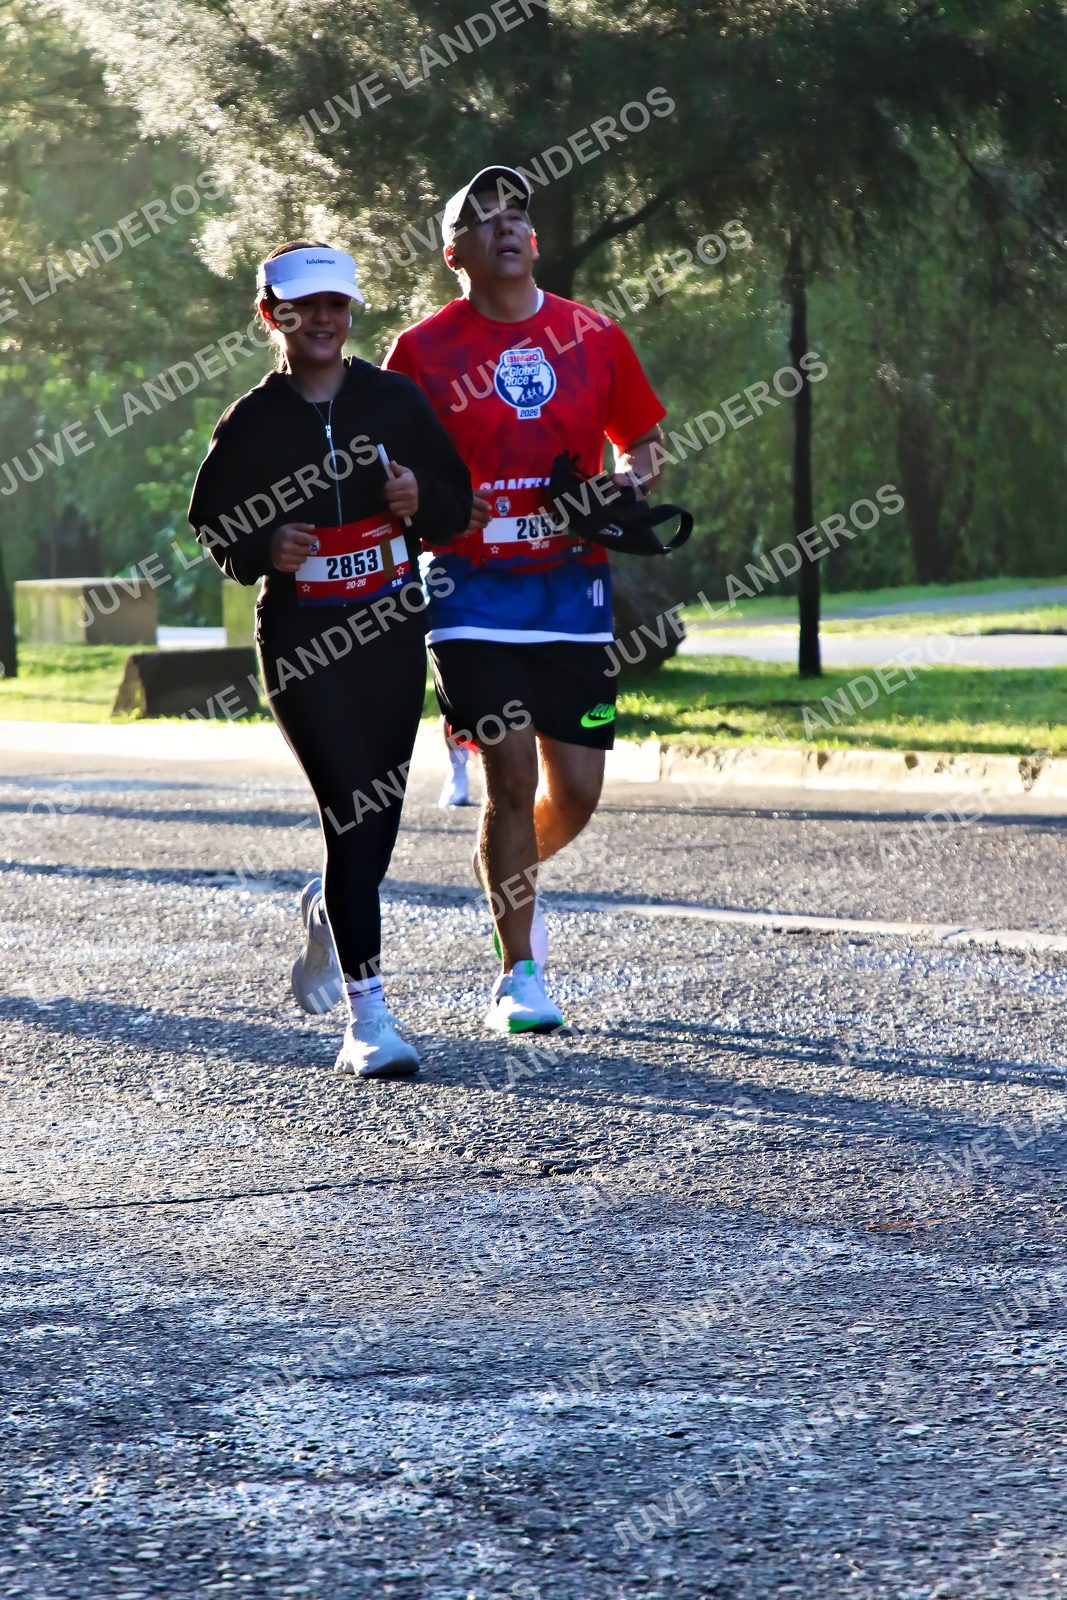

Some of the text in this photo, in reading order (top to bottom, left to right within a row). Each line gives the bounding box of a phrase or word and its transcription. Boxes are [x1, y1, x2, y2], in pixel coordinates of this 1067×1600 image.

[507, 353, 539, 363] BIMBO
[509, 365, 540, 376] Global
[504, 375, 529, 387] Race
[520, 408, 538, 417] 2026
[326, 548, 379, 579] 2853
[346, 578, 366, 589] 20-26
[391, 577, 403, 588] 5K
